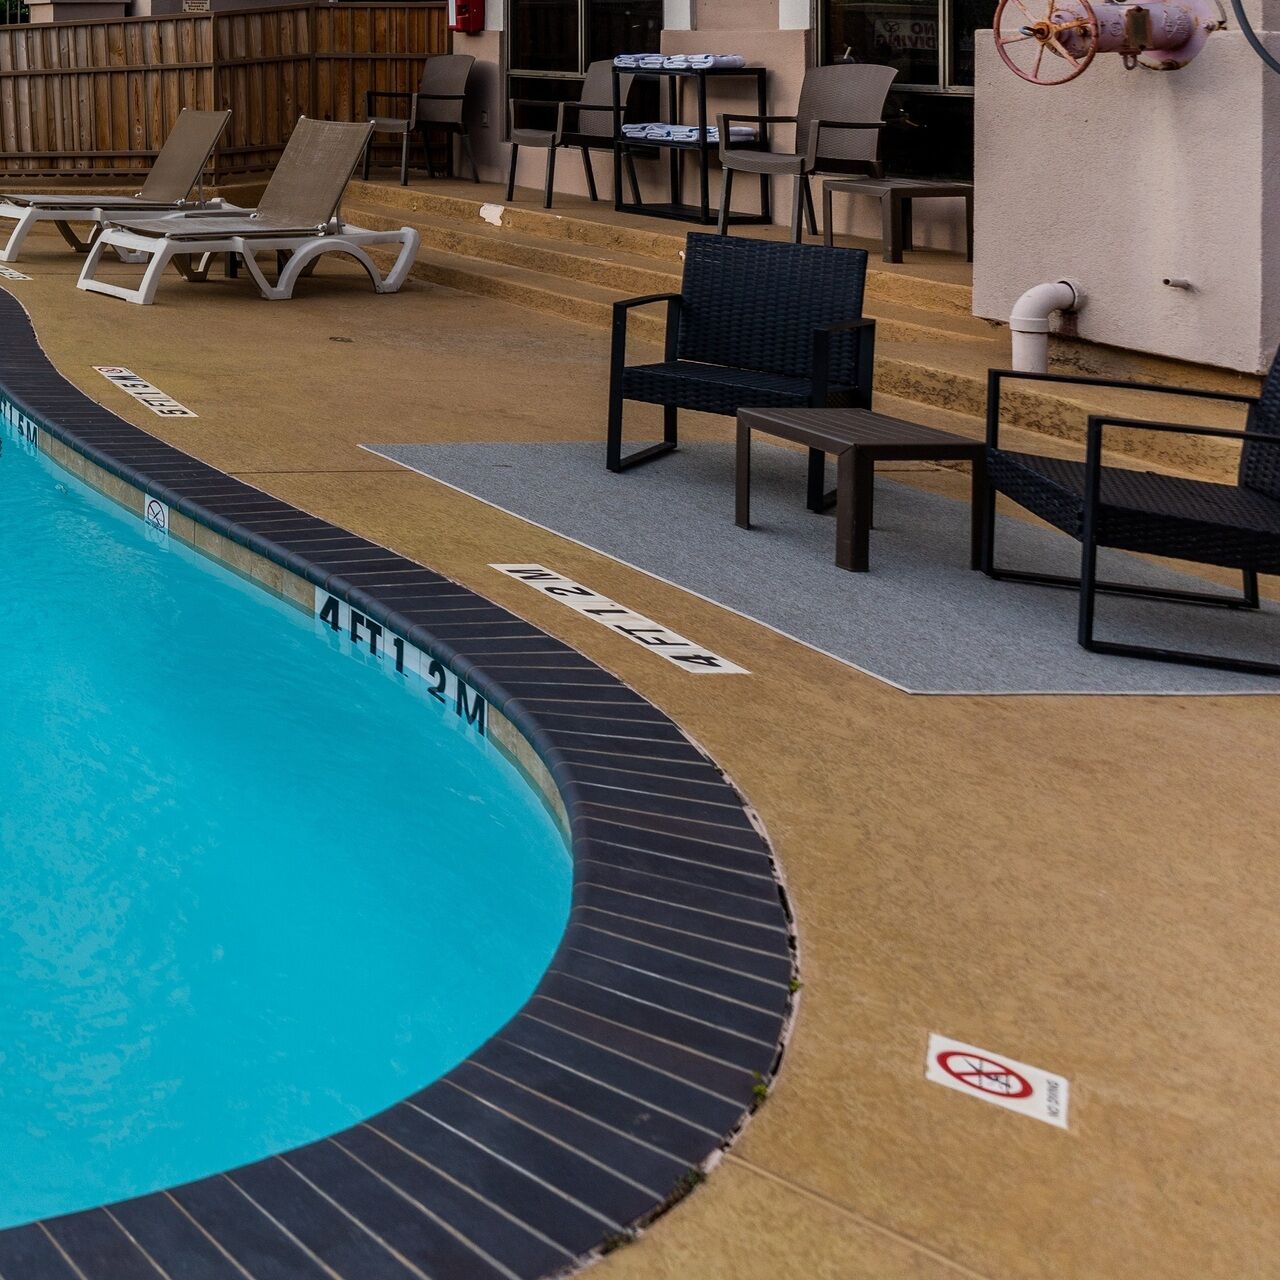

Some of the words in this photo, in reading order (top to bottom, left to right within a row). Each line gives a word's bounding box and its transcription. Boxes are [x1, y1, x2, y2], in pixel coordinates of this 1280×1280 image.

[506, 569, 561, 580] M
[613, 624, 690, 646] FT
[320, 596, 342, 632] 4
[456, 678, 485, 736] M
[670, 654, 722, 668] 4
